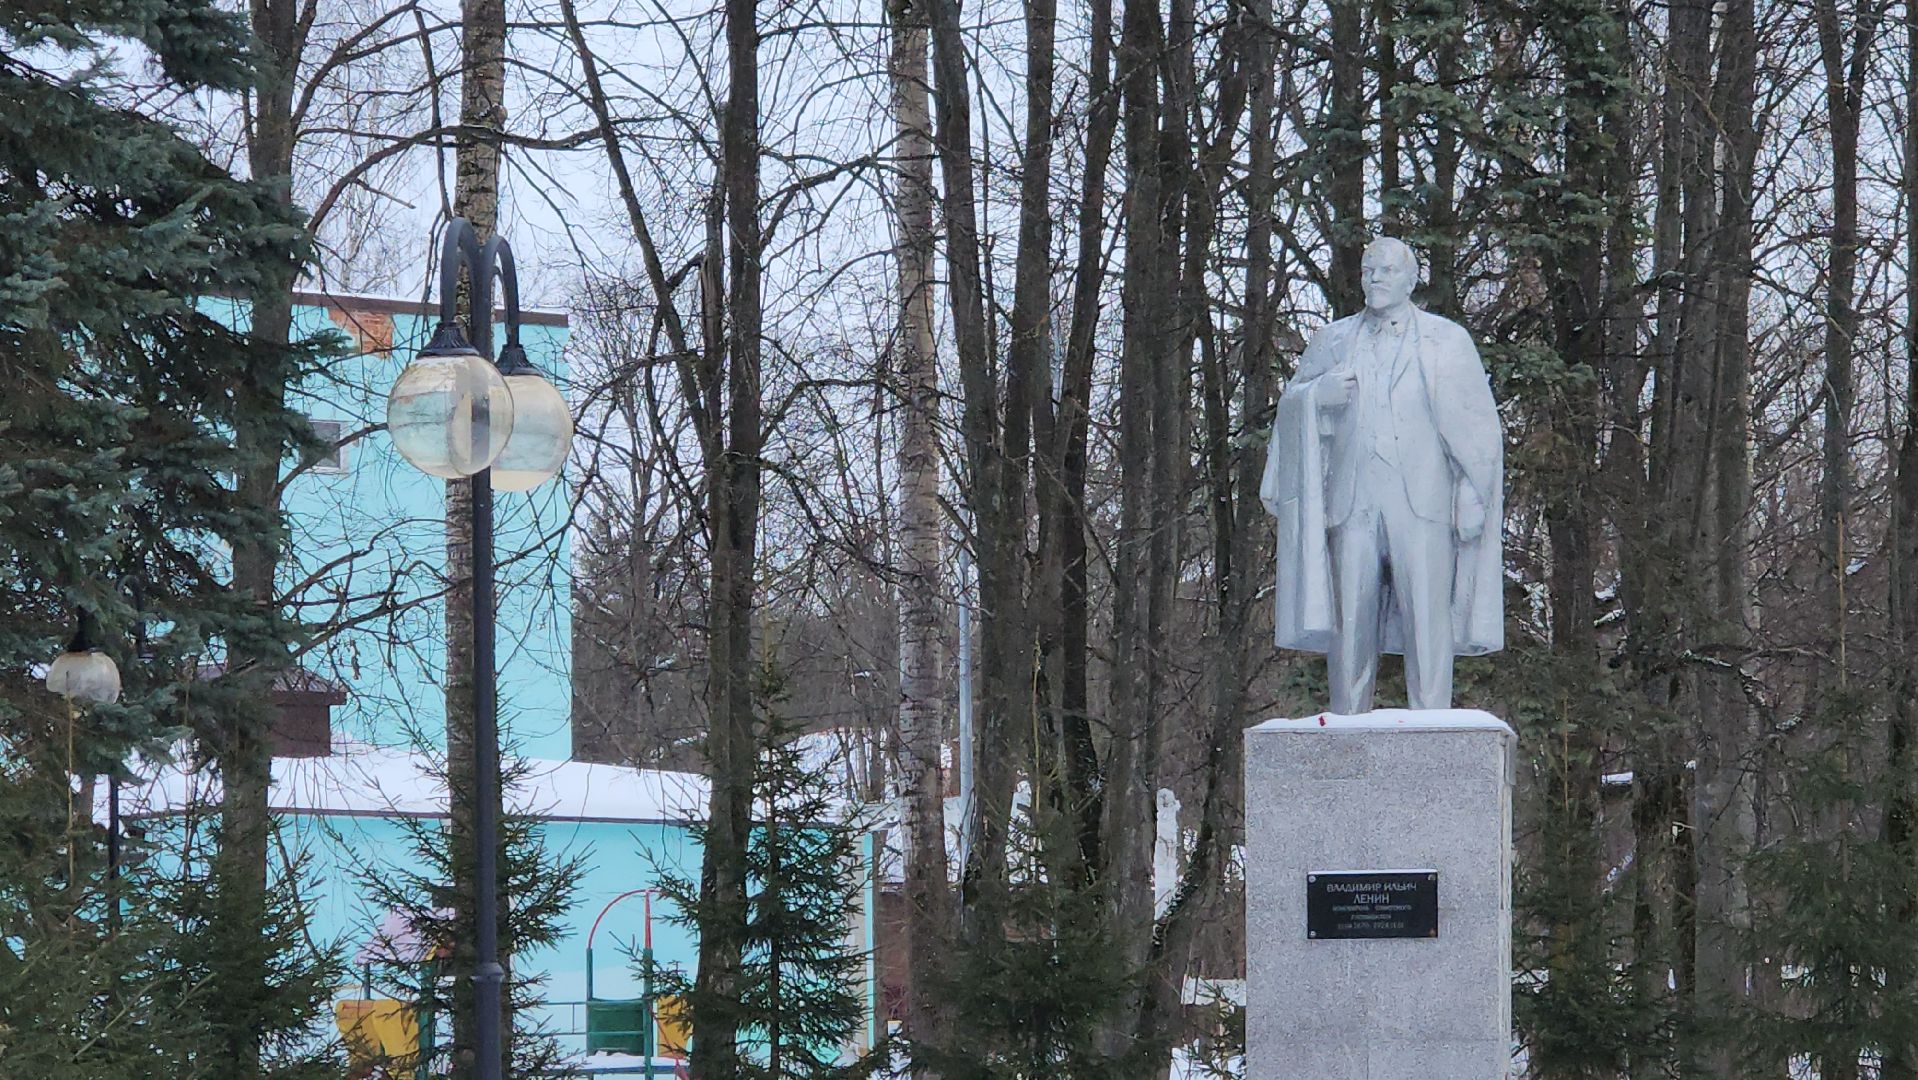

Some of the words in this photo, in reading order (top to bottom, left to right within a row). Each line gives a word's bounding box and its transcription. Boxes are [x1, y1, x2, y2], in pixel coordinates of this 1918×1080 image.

[1326, 883, 1382, 892] ВЛАДИМИР
[1384, 882, 1417, 891] ИЛЬИЧ
[1353, 893, 1390, 904] ЛЕНИН
